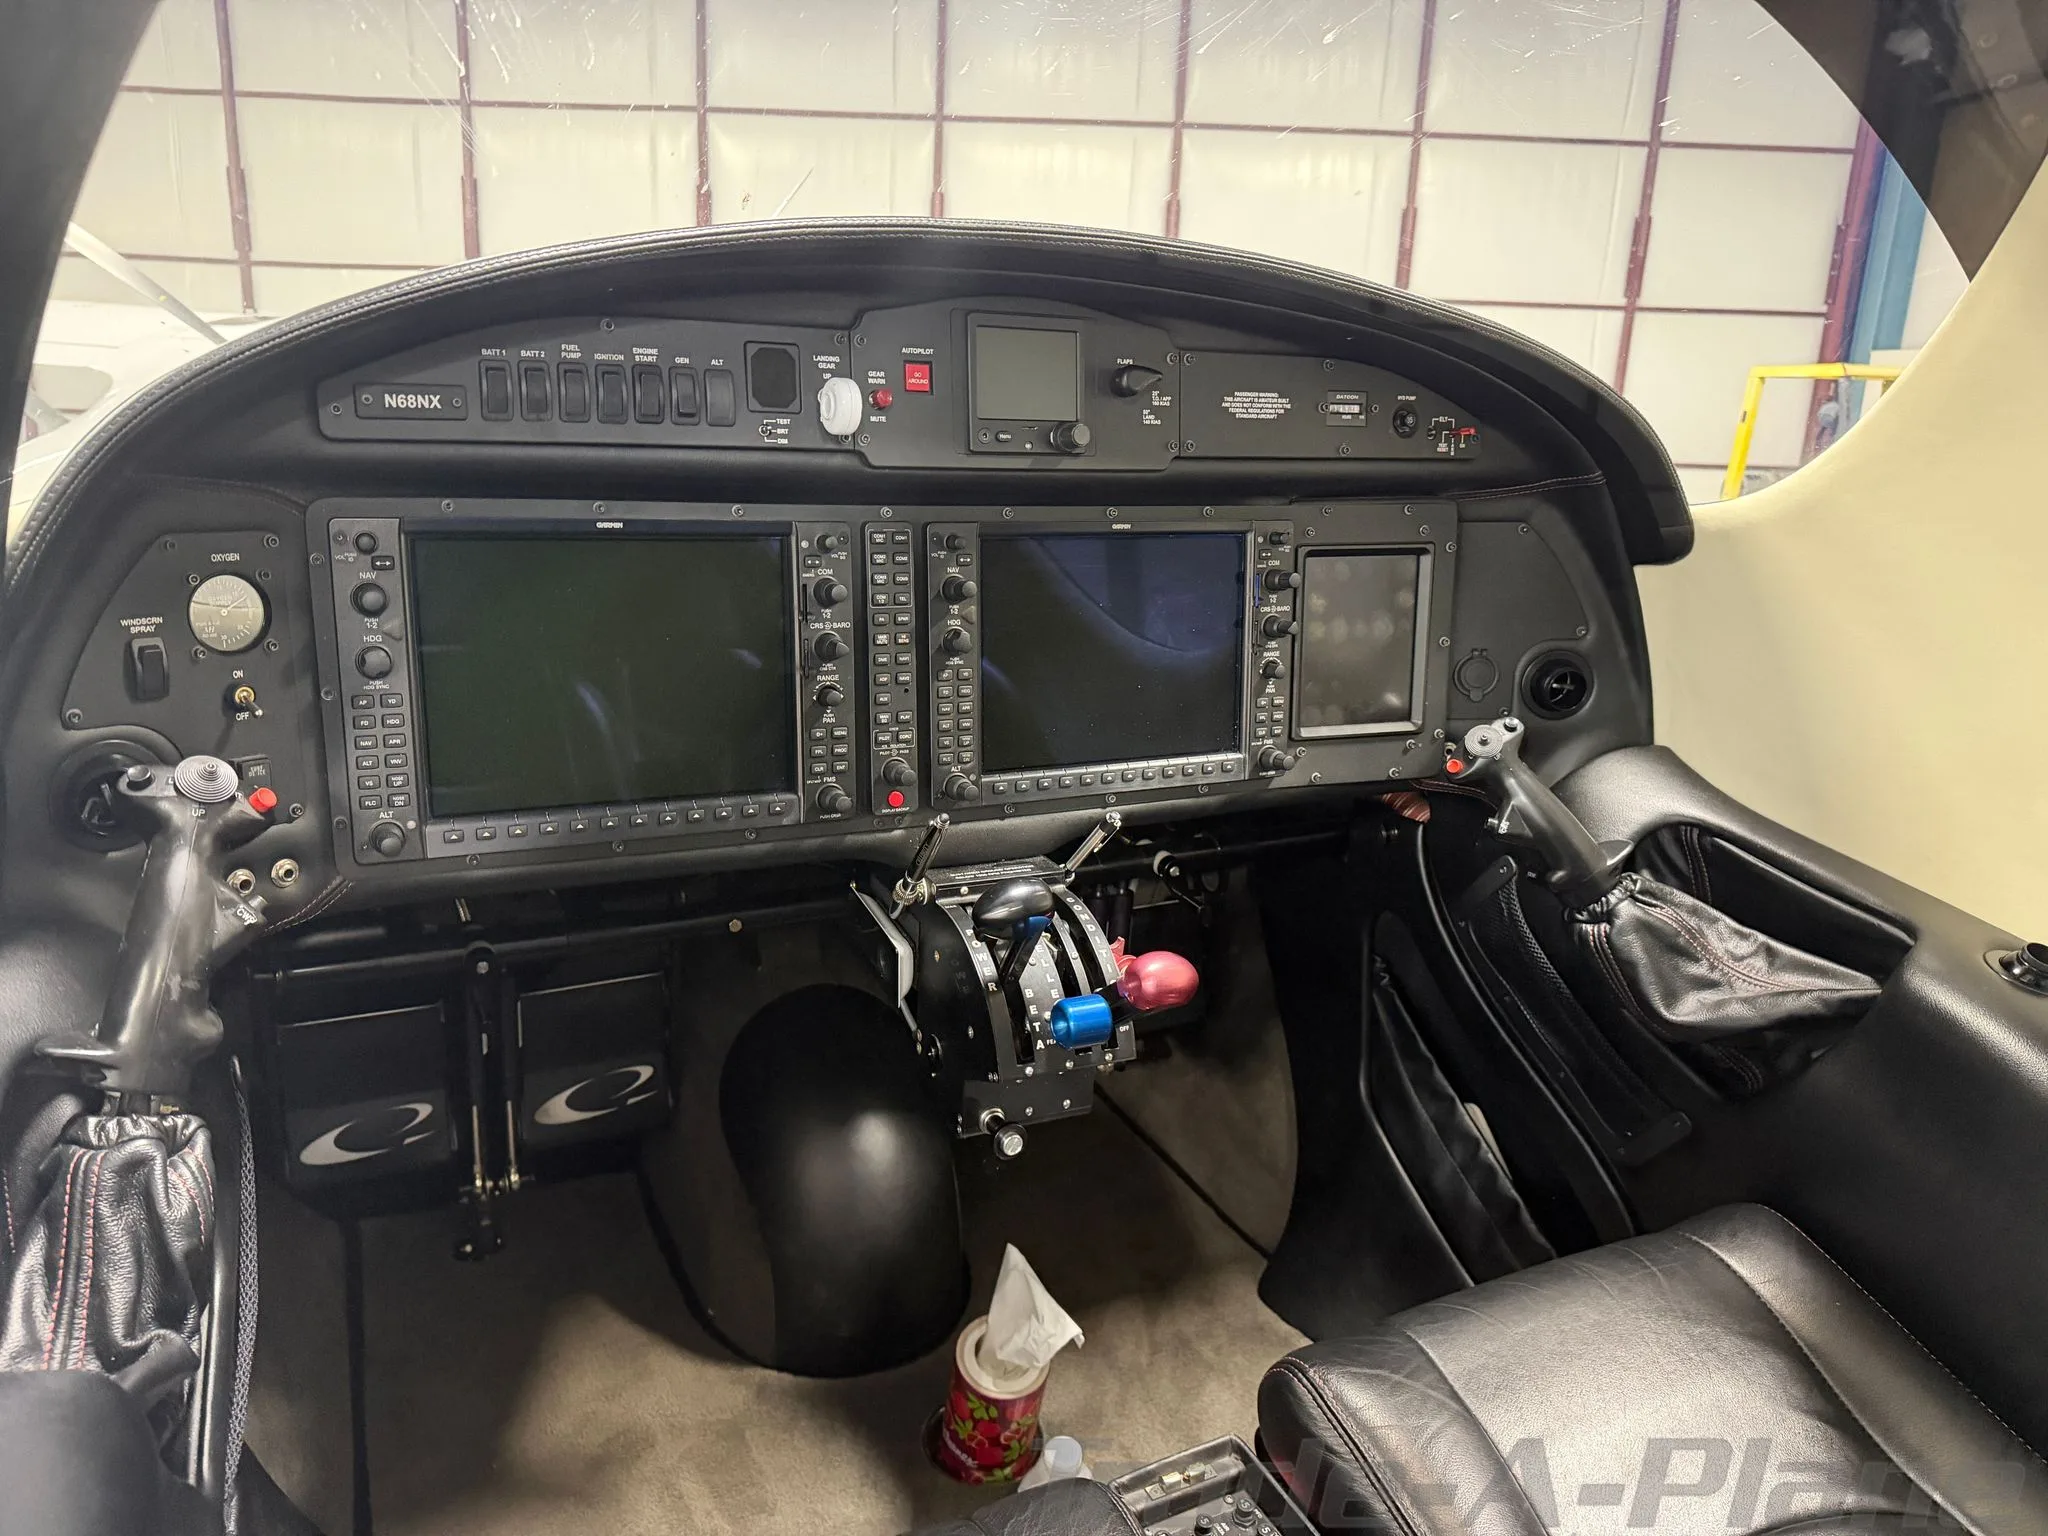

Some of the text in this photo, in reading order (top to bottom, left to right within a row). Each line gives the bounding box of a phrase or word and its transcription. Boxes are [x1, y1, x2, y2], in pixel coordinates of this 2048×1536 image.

[481, 348, 500, 356] BATT
[520, 350, 538, 358] BATT
[594, 353, 624, 361] IGNITION
[711, 358, 723, 366] ALT
[384, 394, 442, 409] N68NX
[211, 553, 240, 562] OXYGEN
[120, 617, 163, 626] WINDSCRN
[130, 625, 156, 634] SPRAY
[233, 670, 243, 678] ON
[236, 712, 249, 721] OFF
[192, 809, 205, 817] UP
[966, 929, 997, 992] POWER
[1025, 988, 1045, 1050] BETA
